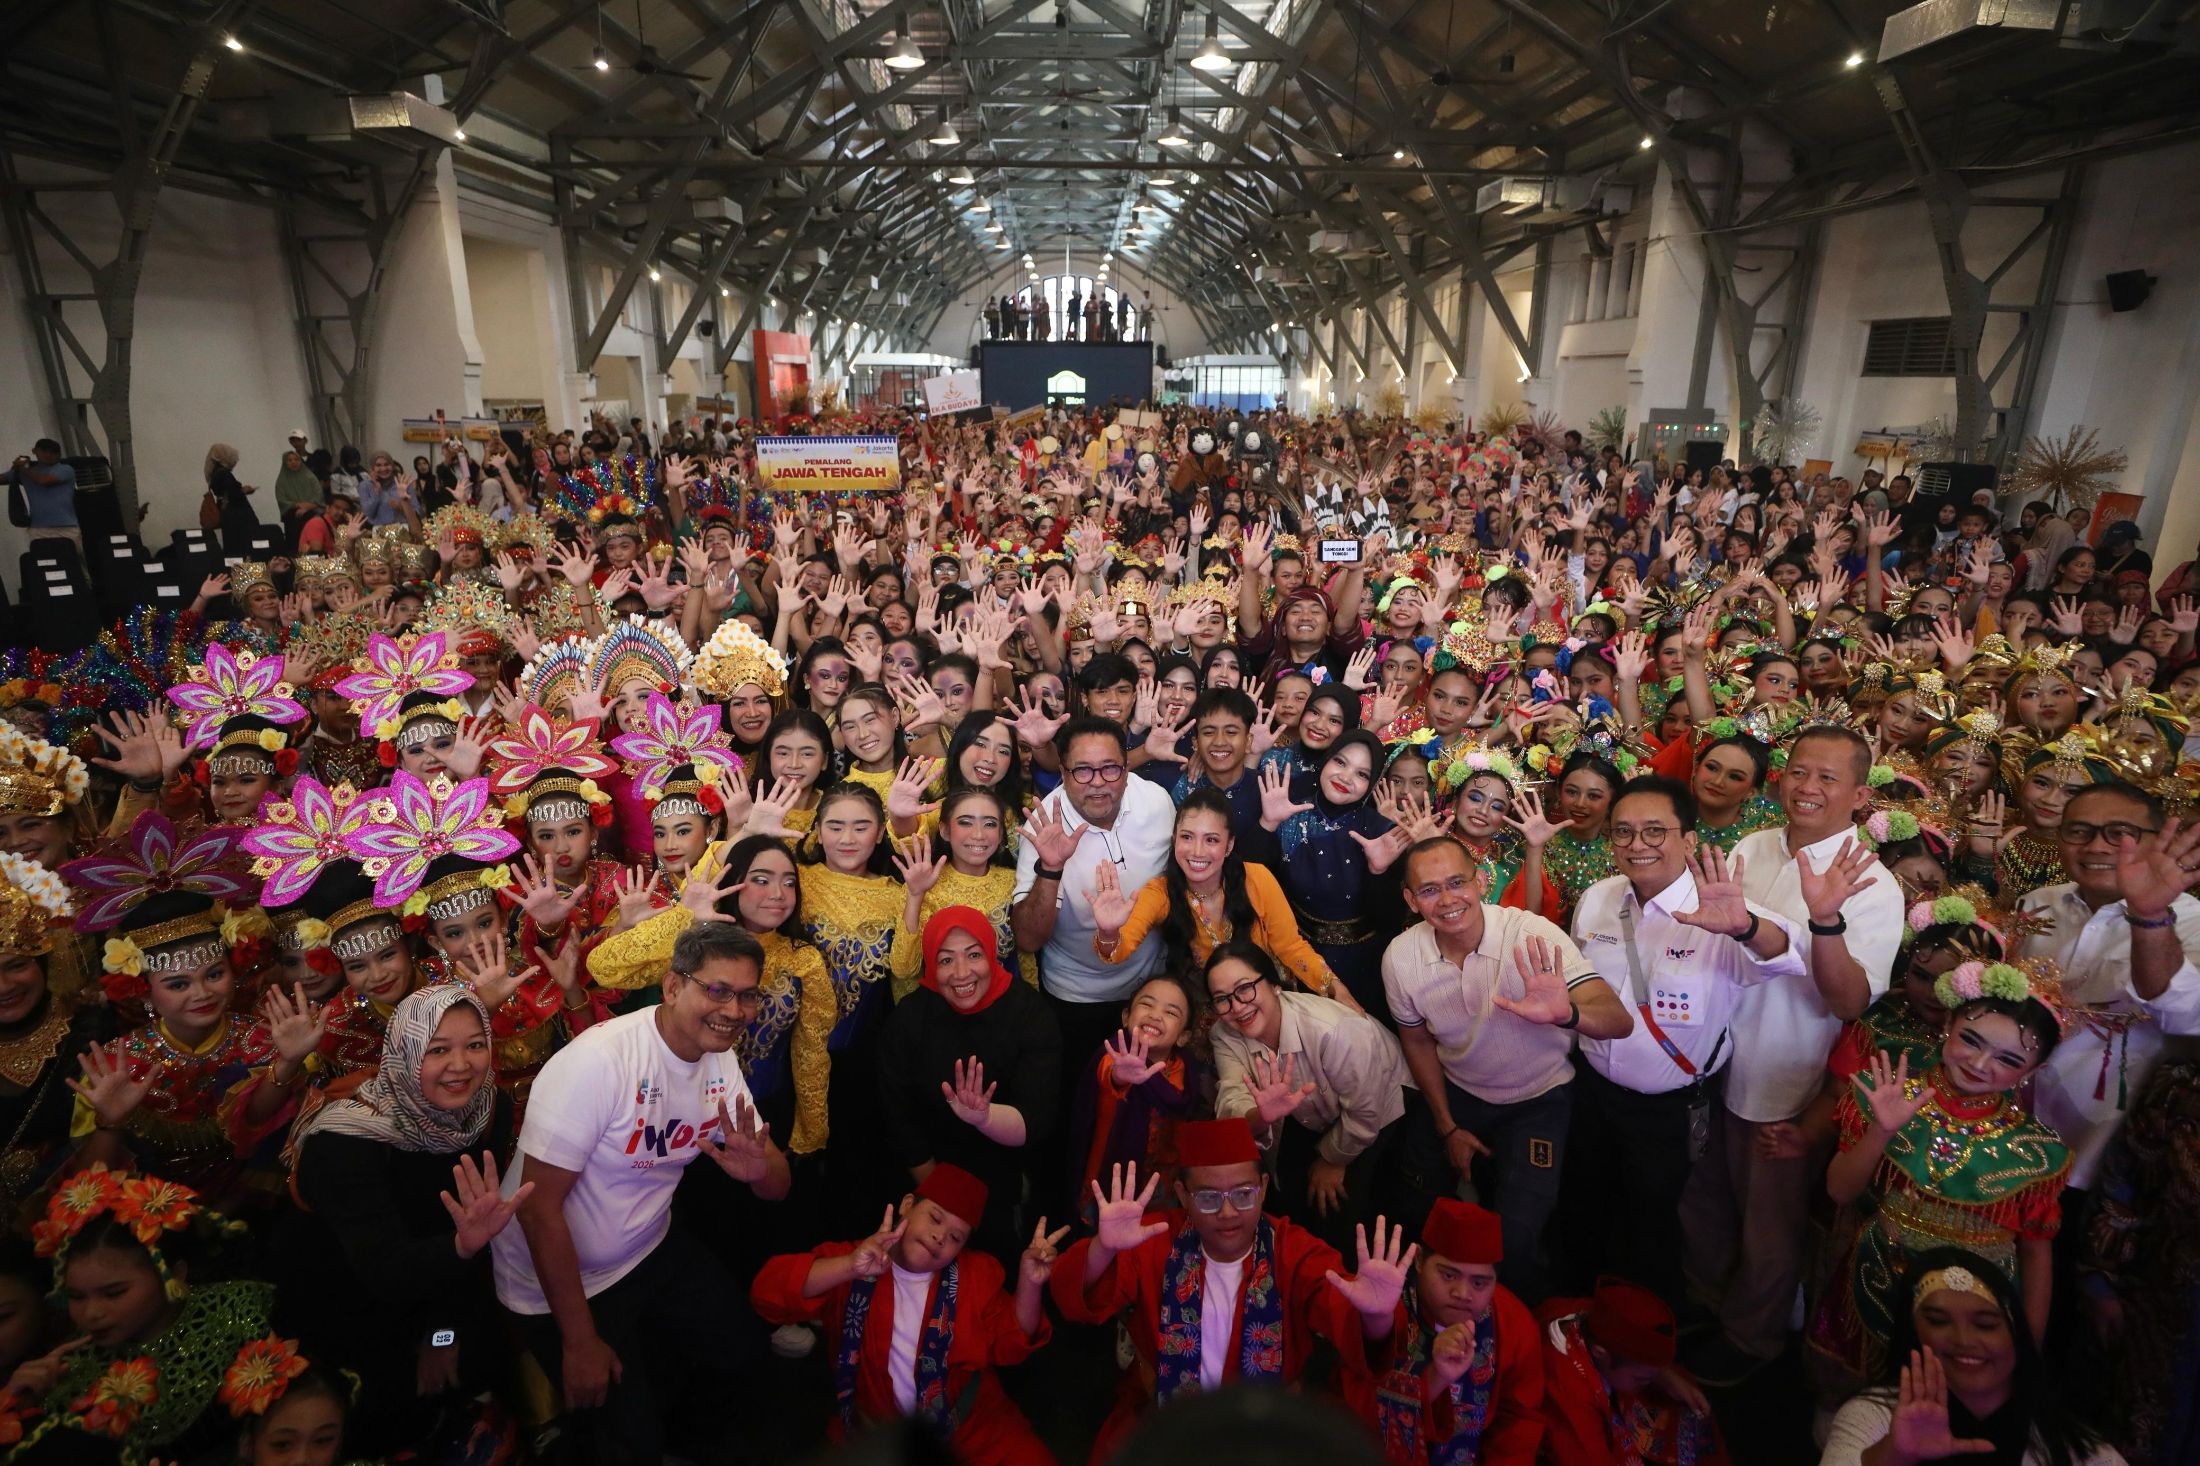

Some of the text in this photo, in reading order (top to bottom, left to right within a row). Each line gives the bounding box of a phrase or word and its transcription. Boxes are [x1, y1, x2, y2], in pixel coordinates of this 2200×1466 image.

[931, 405, 946, 414] EKA
[947, 399, 979, 411] BUDAYA
[773, 467, 887, 478] JAWA TENGAH
[631, 1160, 654, 1169] 2026
